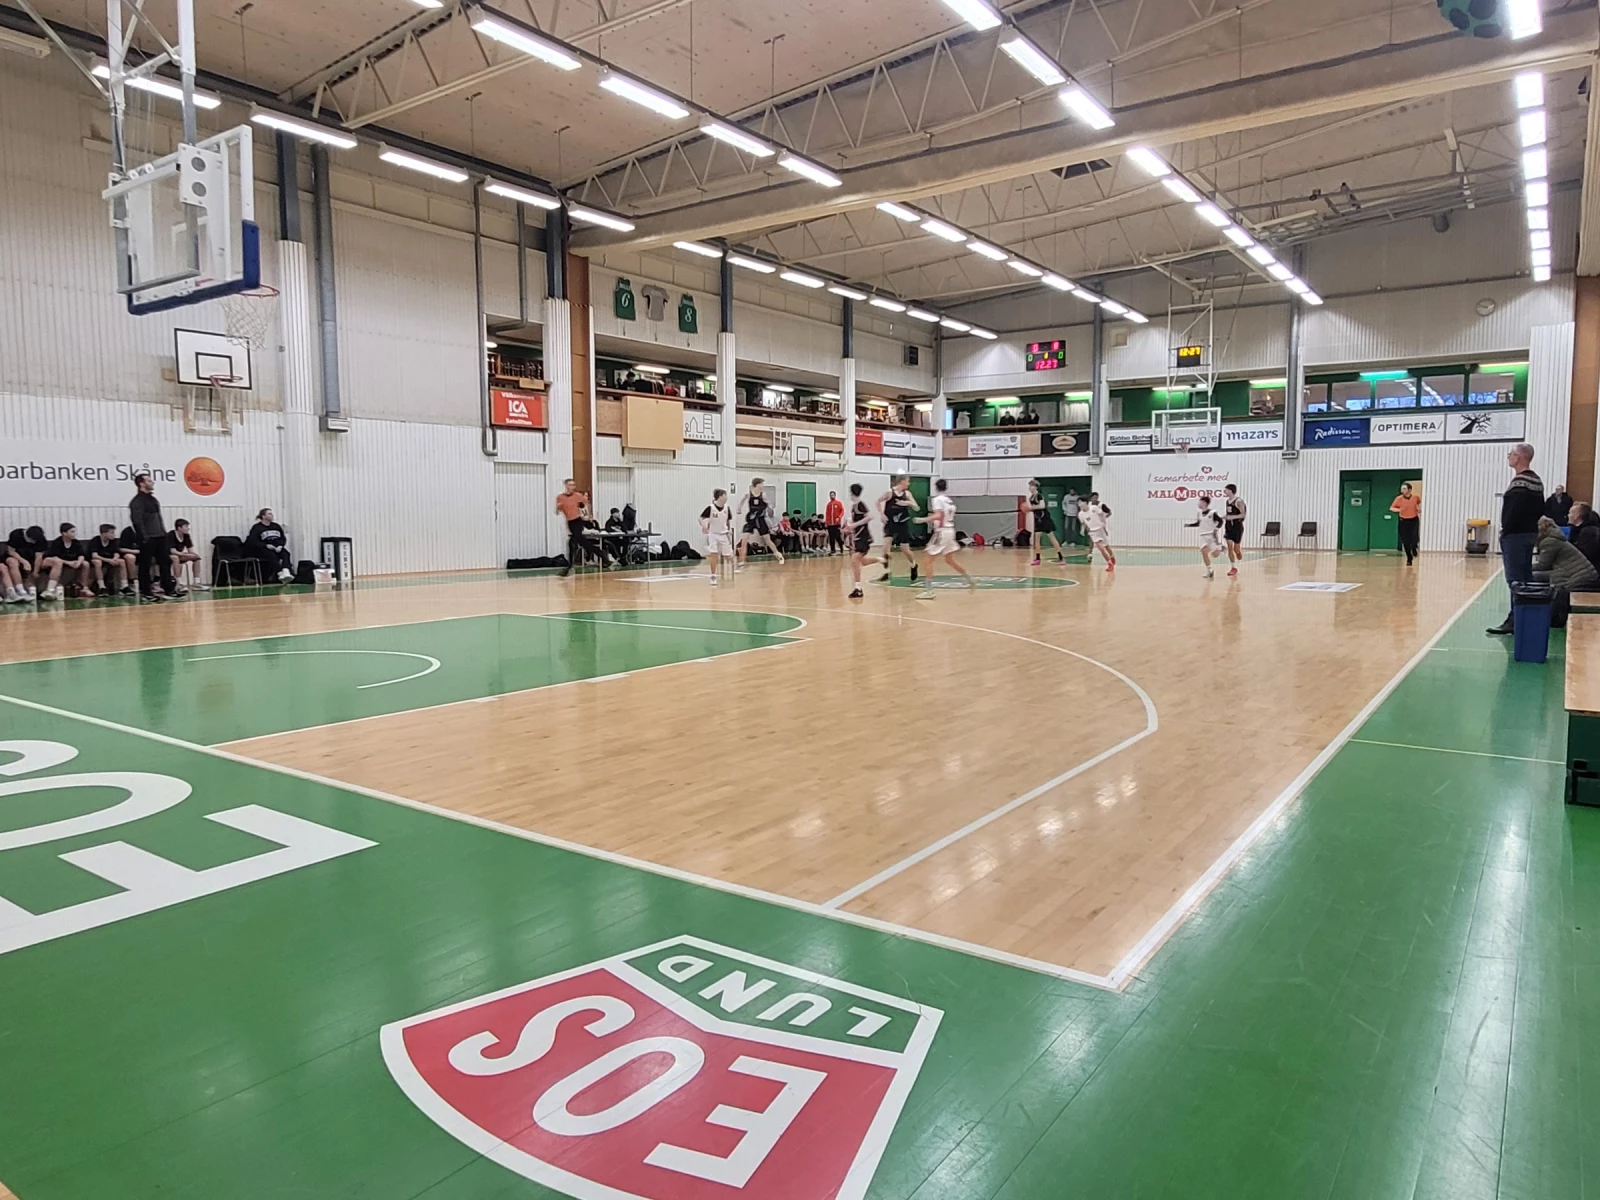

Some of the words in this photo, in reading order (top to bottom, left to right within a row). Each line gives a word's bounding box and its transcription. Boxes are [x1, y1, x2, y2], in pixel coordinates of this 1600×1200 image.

[621, 292, 631, 308] 6
[684, 307, 693, 323] 8
[508, 400, 528, 414] ICA
[1226, 428, 1279, 441] mazars
[1314, 426, 1352, 441] Radisson
[1153, 472, 1205, 483] samarbete
[1206, 471, 1230, 482] med
[657, 954, 893, 1039] LUND
[447, 994, 829, 1189] EOS
